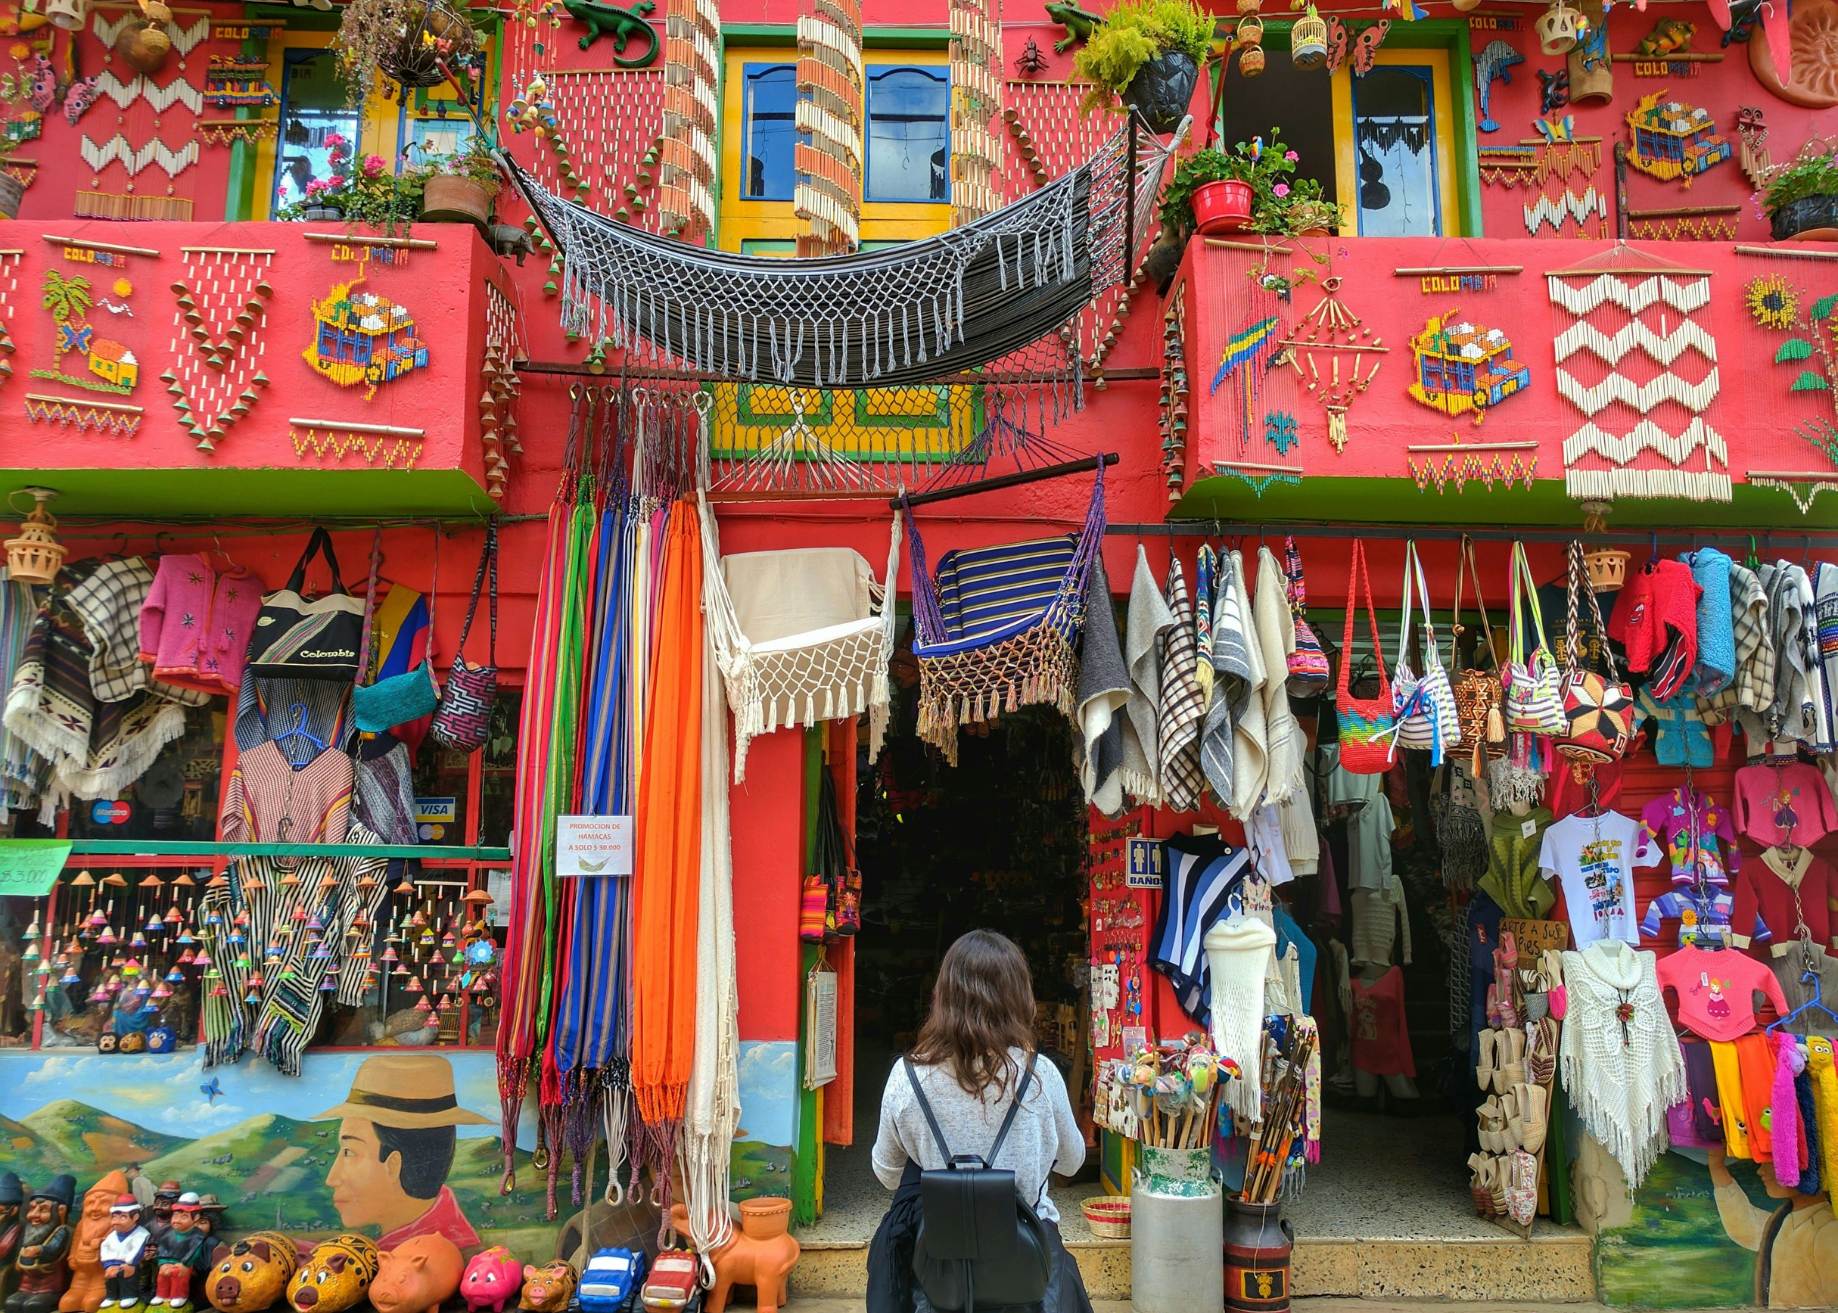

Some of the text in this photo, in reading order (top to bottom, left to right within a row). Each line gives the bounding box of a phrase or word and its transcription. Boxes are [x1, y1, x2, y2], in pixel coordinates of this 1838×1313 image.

[215, 27, 283, 39] COLOMBIA
[1635, 61, 1701, 77] COLOMBIA
[63, 247, 126, 269] COLOMBIA
[331, 244, 409, 265] COLOMBIA
[1421, 274, 1497, 293] COLOMBIA
[300, 648, 356, 659] Colombia
[421, 804, 448, 815] VISA
[1130, 876, 1162, 886] BAÑO
